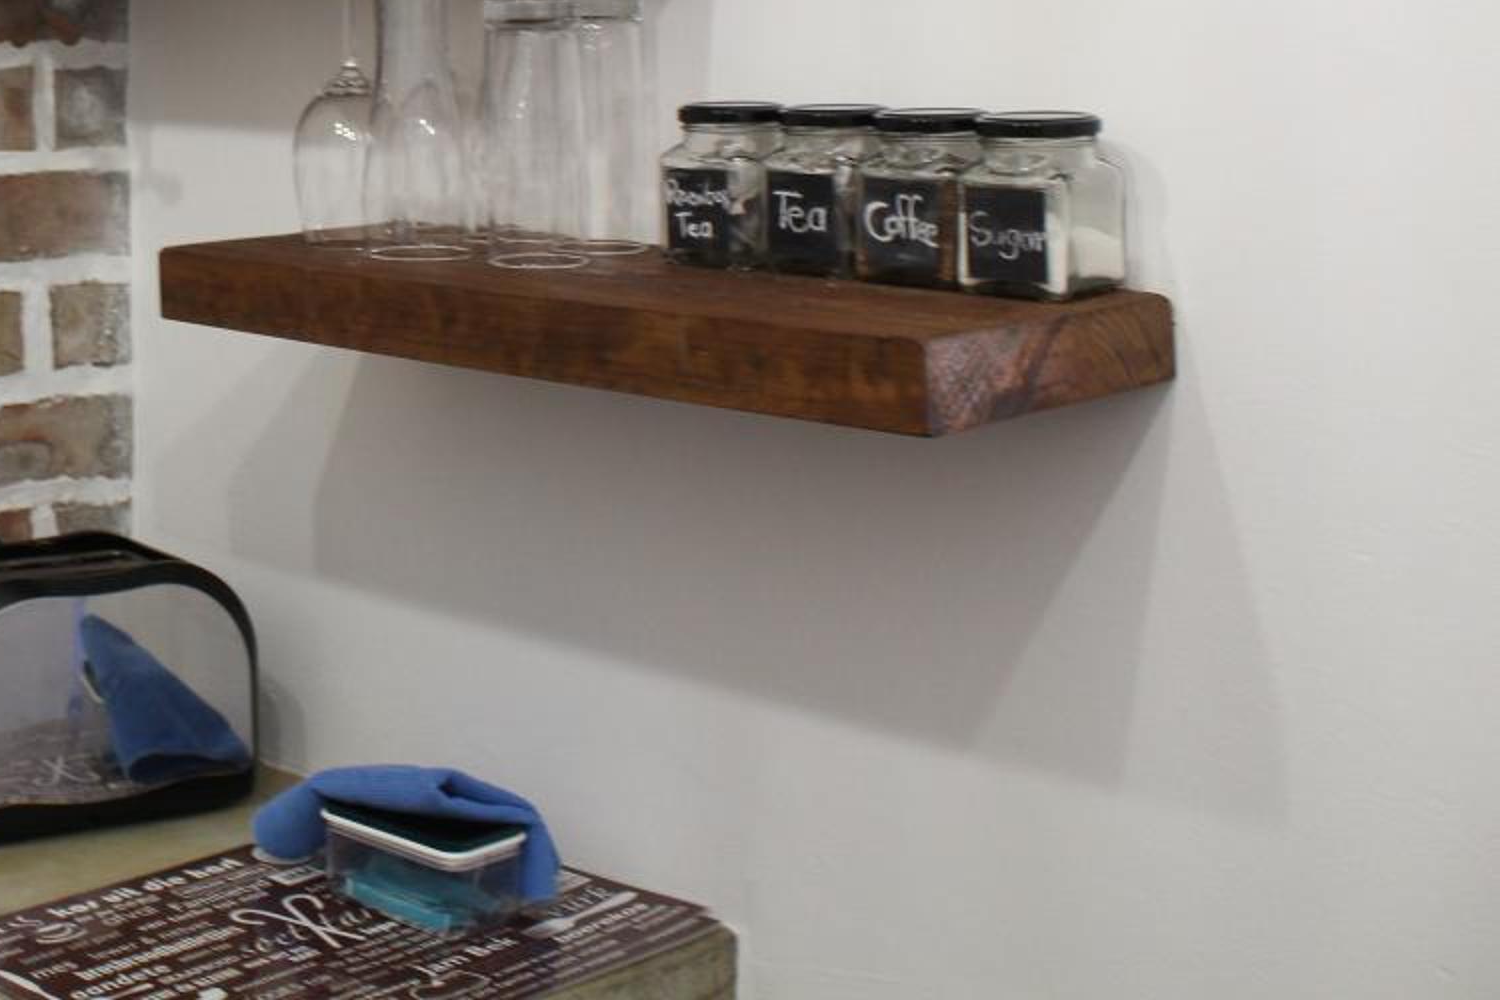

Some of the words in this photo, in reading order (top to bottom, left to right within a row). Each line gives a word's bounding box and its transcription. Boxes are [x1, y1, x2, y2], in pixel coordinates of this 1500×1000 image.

[674, 210, 714, 239] Tea
[771, 189, 828, 233] Tea
[862, 193, 940, 248] Coffee
[969, 210, 1047, 260] Sugar
